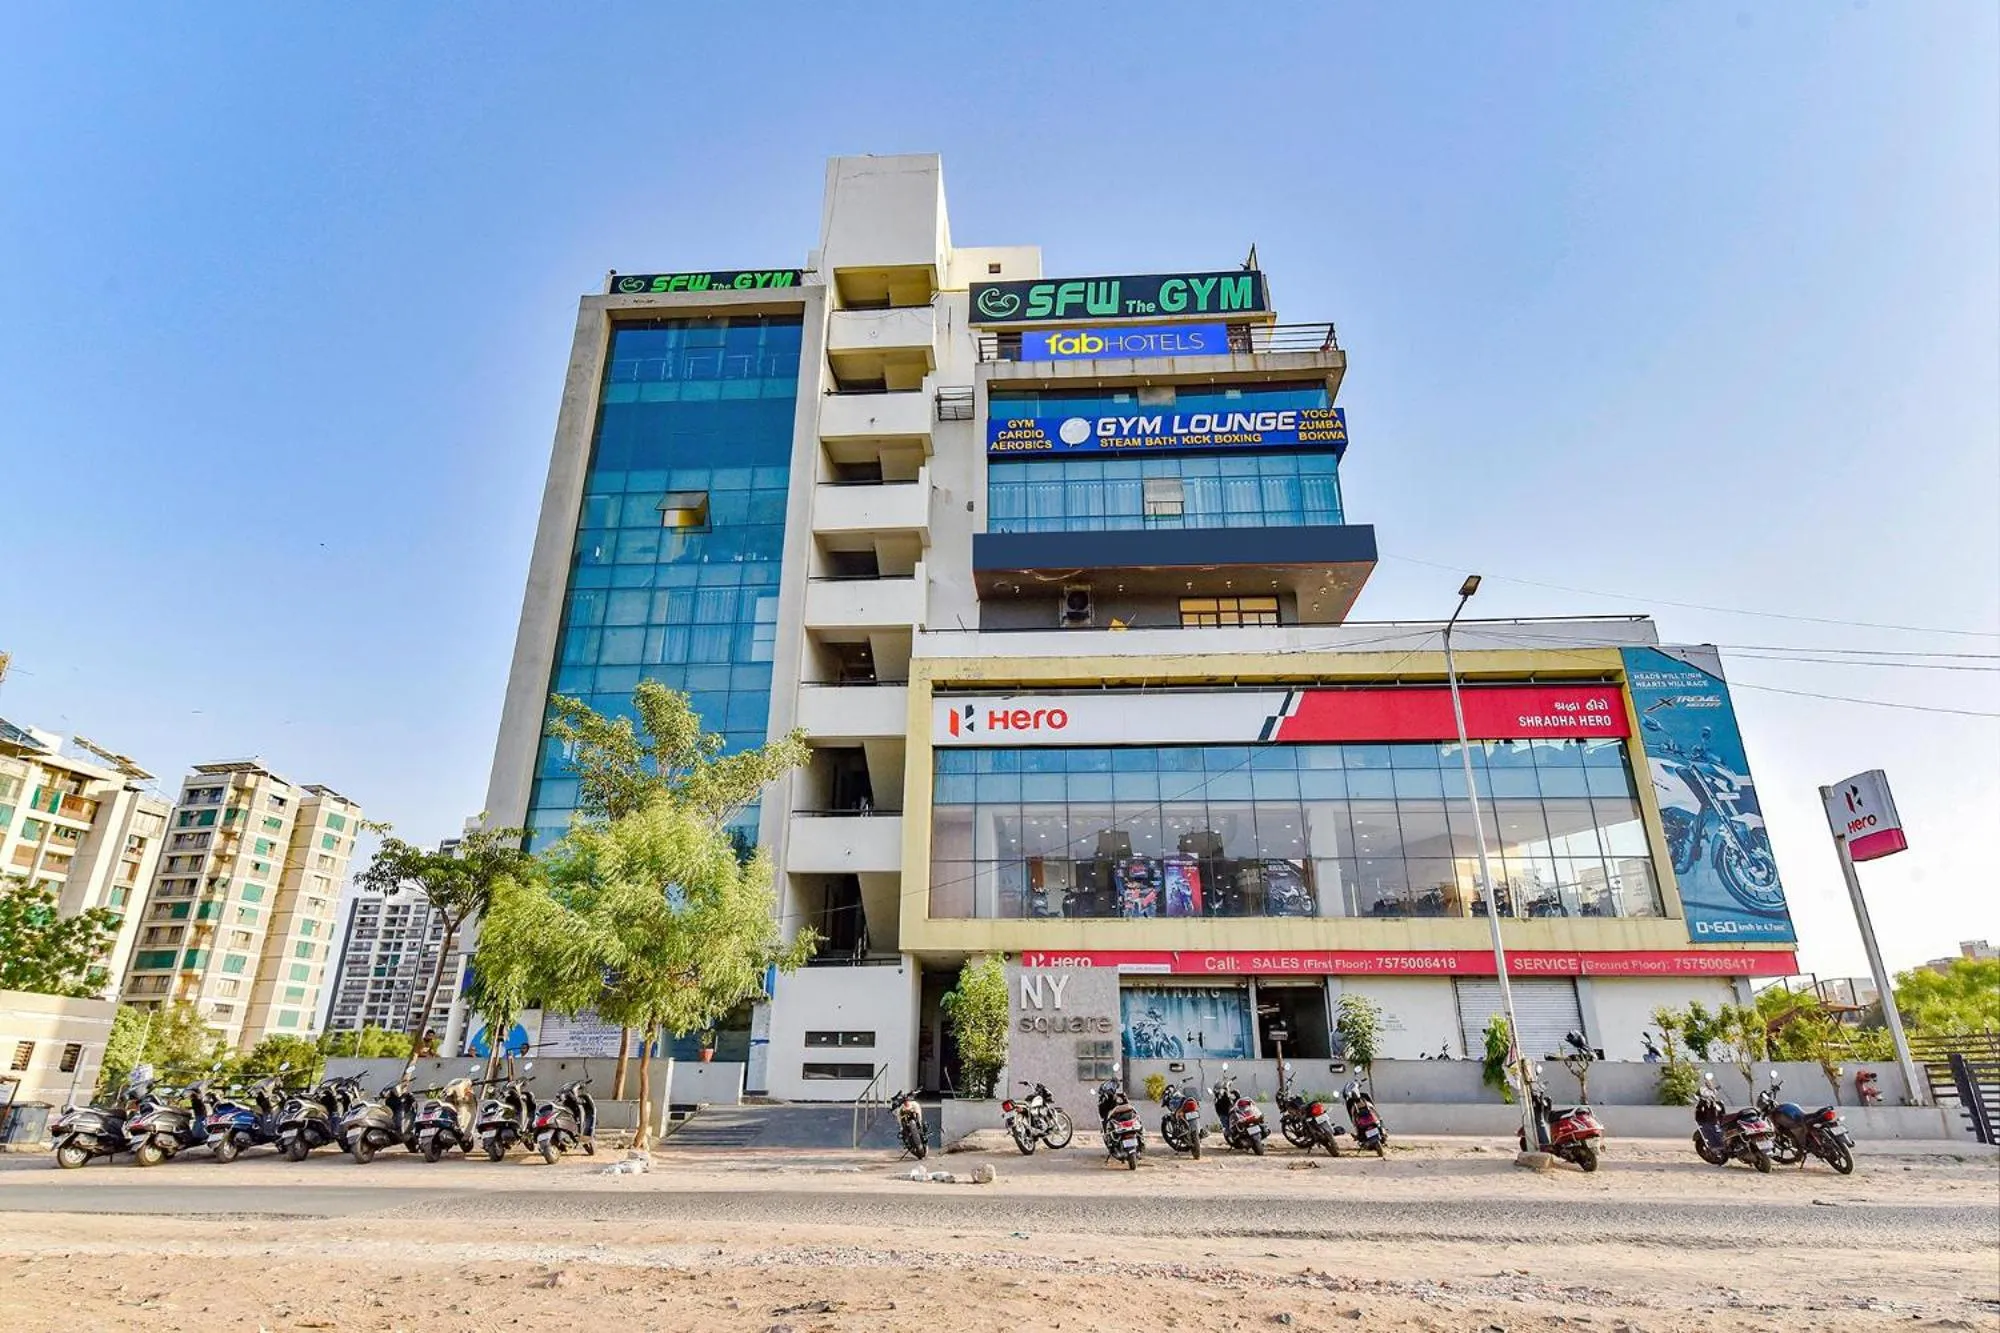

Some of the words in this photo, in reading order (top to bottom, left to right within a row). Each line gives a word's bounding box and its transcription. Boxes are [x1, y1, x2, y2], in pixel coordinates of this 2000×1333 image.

[650, 274, 712, 293] SFW
[712, 283, 731, 291] The
[734, 271, 795, 289] GYM
[1025, 281, 1120, 317] SFW
[1126, 300, 1156, 314] The
[1159, 276, 1253, 312] GYM
[1301, 409, 1338, 419] YOGA
[1007, 419, 1035, 430] GYM
[1096, 415, 1163, 437] GYM
[1172, 411, 1297, 434] LOUNGE
[1298, 419, 1344, 430] ZUMBA
[997, 428, 1045, 440] CARDIO
[1298, 430, 1346, 442] BOKWA
[990, 439, 1053, 451] AEROBICS
[1100, 436, 1142, 448] STEAM
[1145, 435, 1177, 446] BATH
[1182, 434, 1212, 445] KICK
[1214, 433, 1262, 445] BOXING
[1634, 672, 1661, 680] HEADS
[1662, 672, 1680, 680] WILL
[1635, 680, 1668, 688] HEARTS
[1518, 715, 1577, 727] SHRADHA
[1579, 715, 1612, 726] HERO
[1204, 957, 1240, 970] Call:
[1252, 958, 1299, 969] SALES
[1303, 959, 1332, 970] (First
[1335, 959, 1372, 970] Floor):
[1376, 957, 1457, 969] 7575006418
[1513, 958, 1578, 970] SERVICE
[1581, 959, 1628, 971] (Ground
[1631, 959, 1670, 971] Floor):
[1019, 974, 1070, 1010] NY
[1018, 1014, 1113, 1038] square
